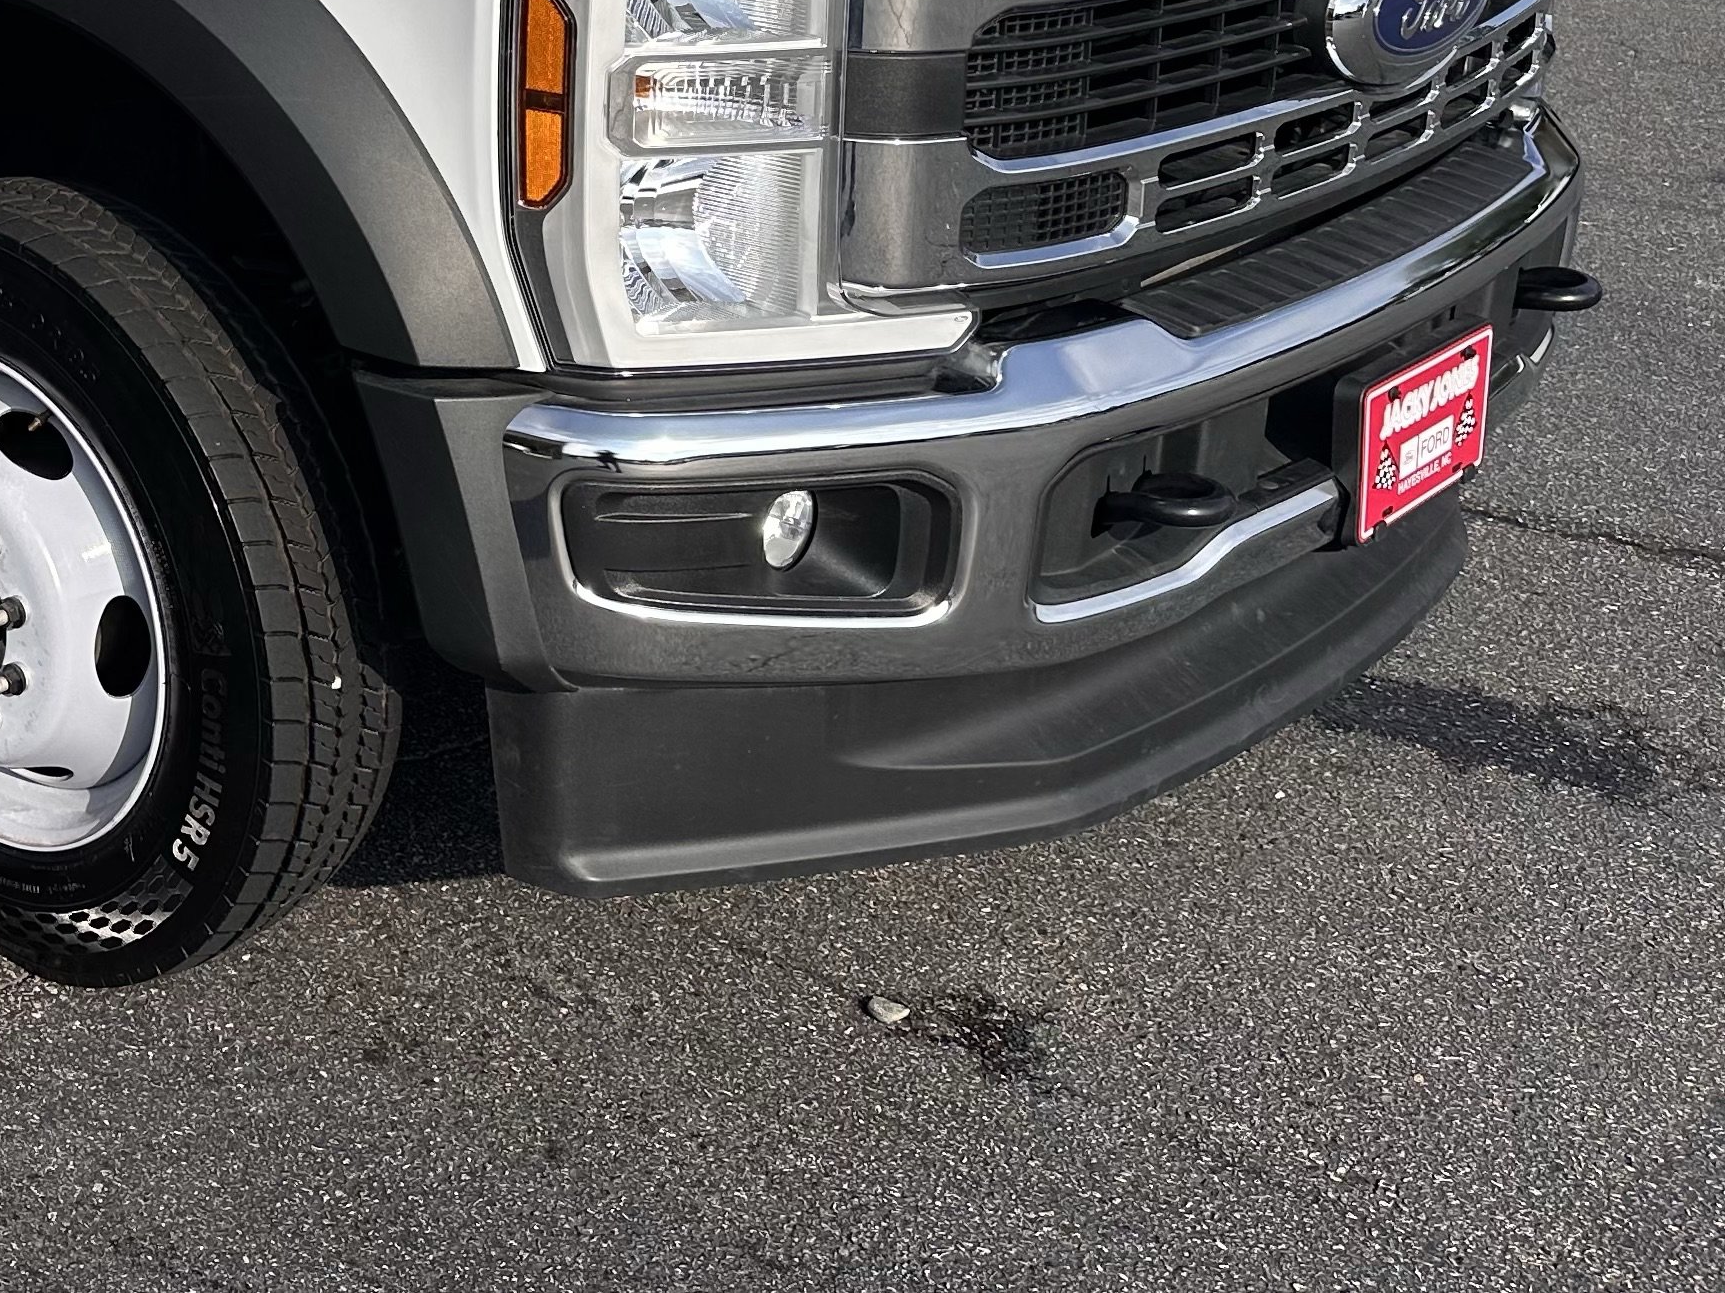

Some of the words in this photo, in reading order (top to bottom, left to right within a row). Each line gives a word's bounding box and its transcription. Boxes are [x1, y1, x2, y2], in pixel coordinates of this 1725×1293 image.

[1379, 380, 1435, 441] JACKY
[1429, 354, 1480, 412] JONES
[1420, 425, 1451, 459] FORD
[1441, 451, 1453, 469] NC
